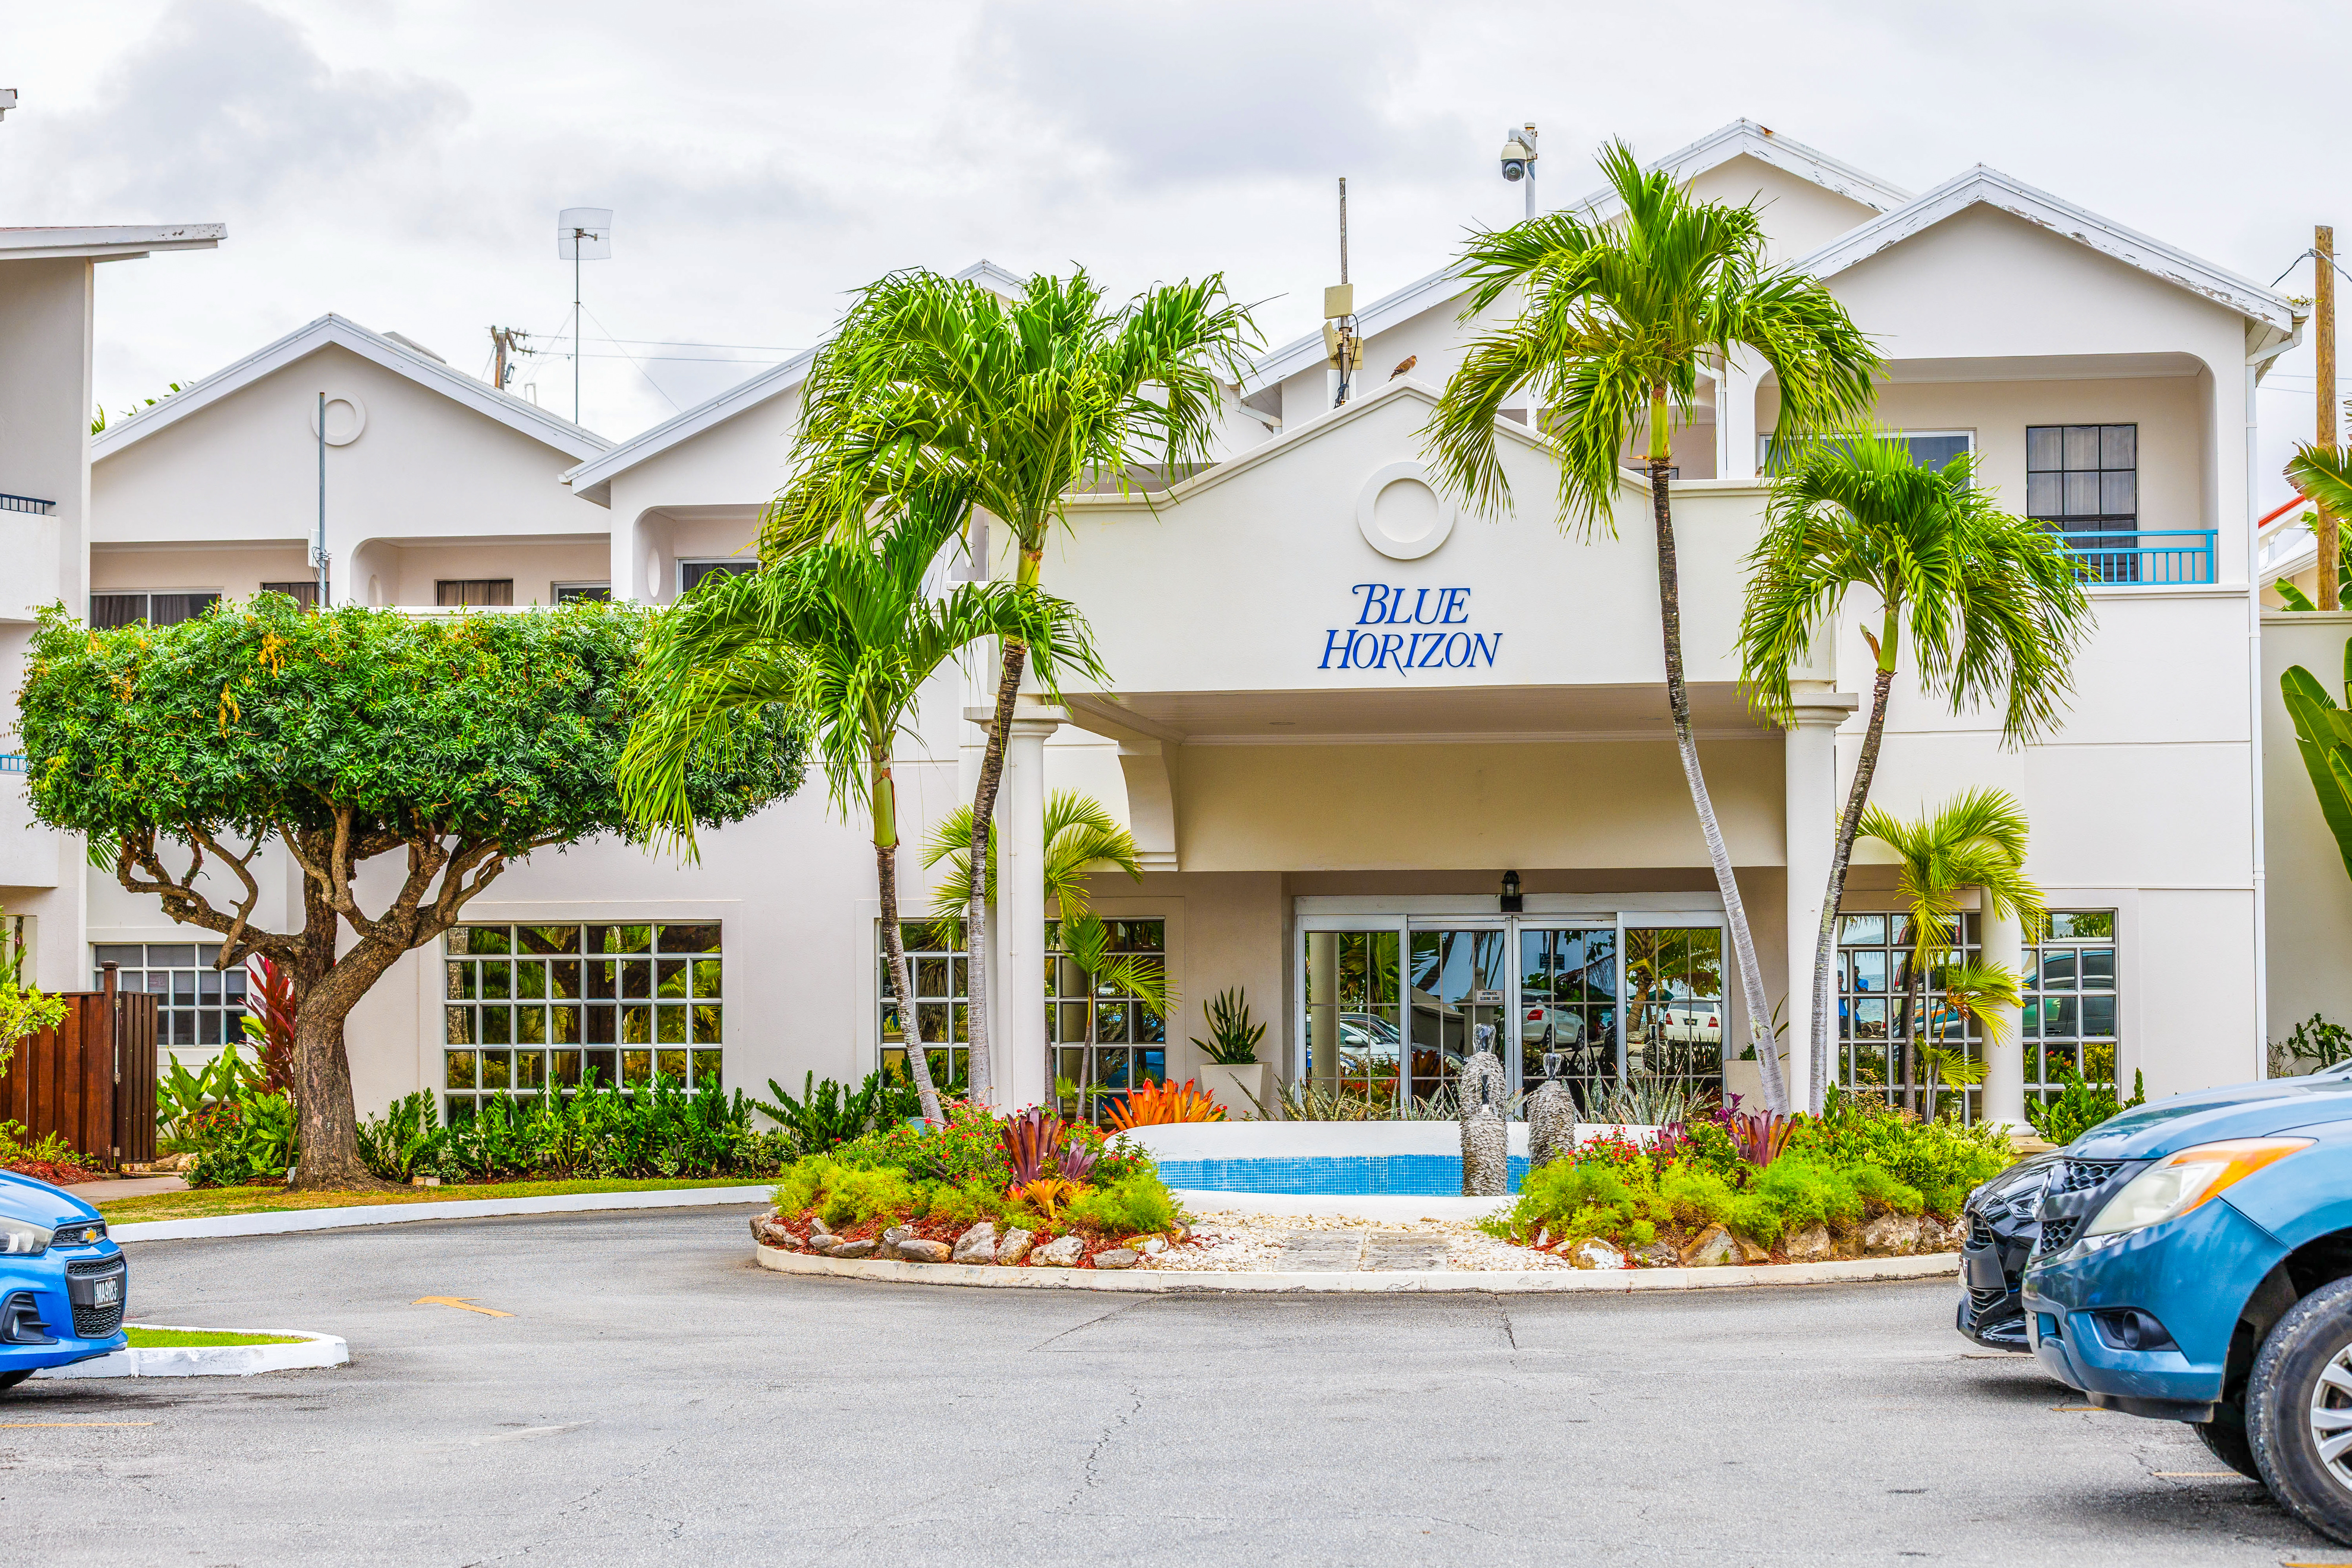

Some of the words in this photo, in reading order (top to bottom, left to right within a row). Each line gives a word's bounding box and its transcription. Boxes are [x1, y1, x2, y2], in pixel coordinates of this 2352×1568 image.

[1352, 584, 1470, 624] BLUE
[1317, 629, 1503, 677] HORIZON
[96, 1280, 117, 1303] MA9183
